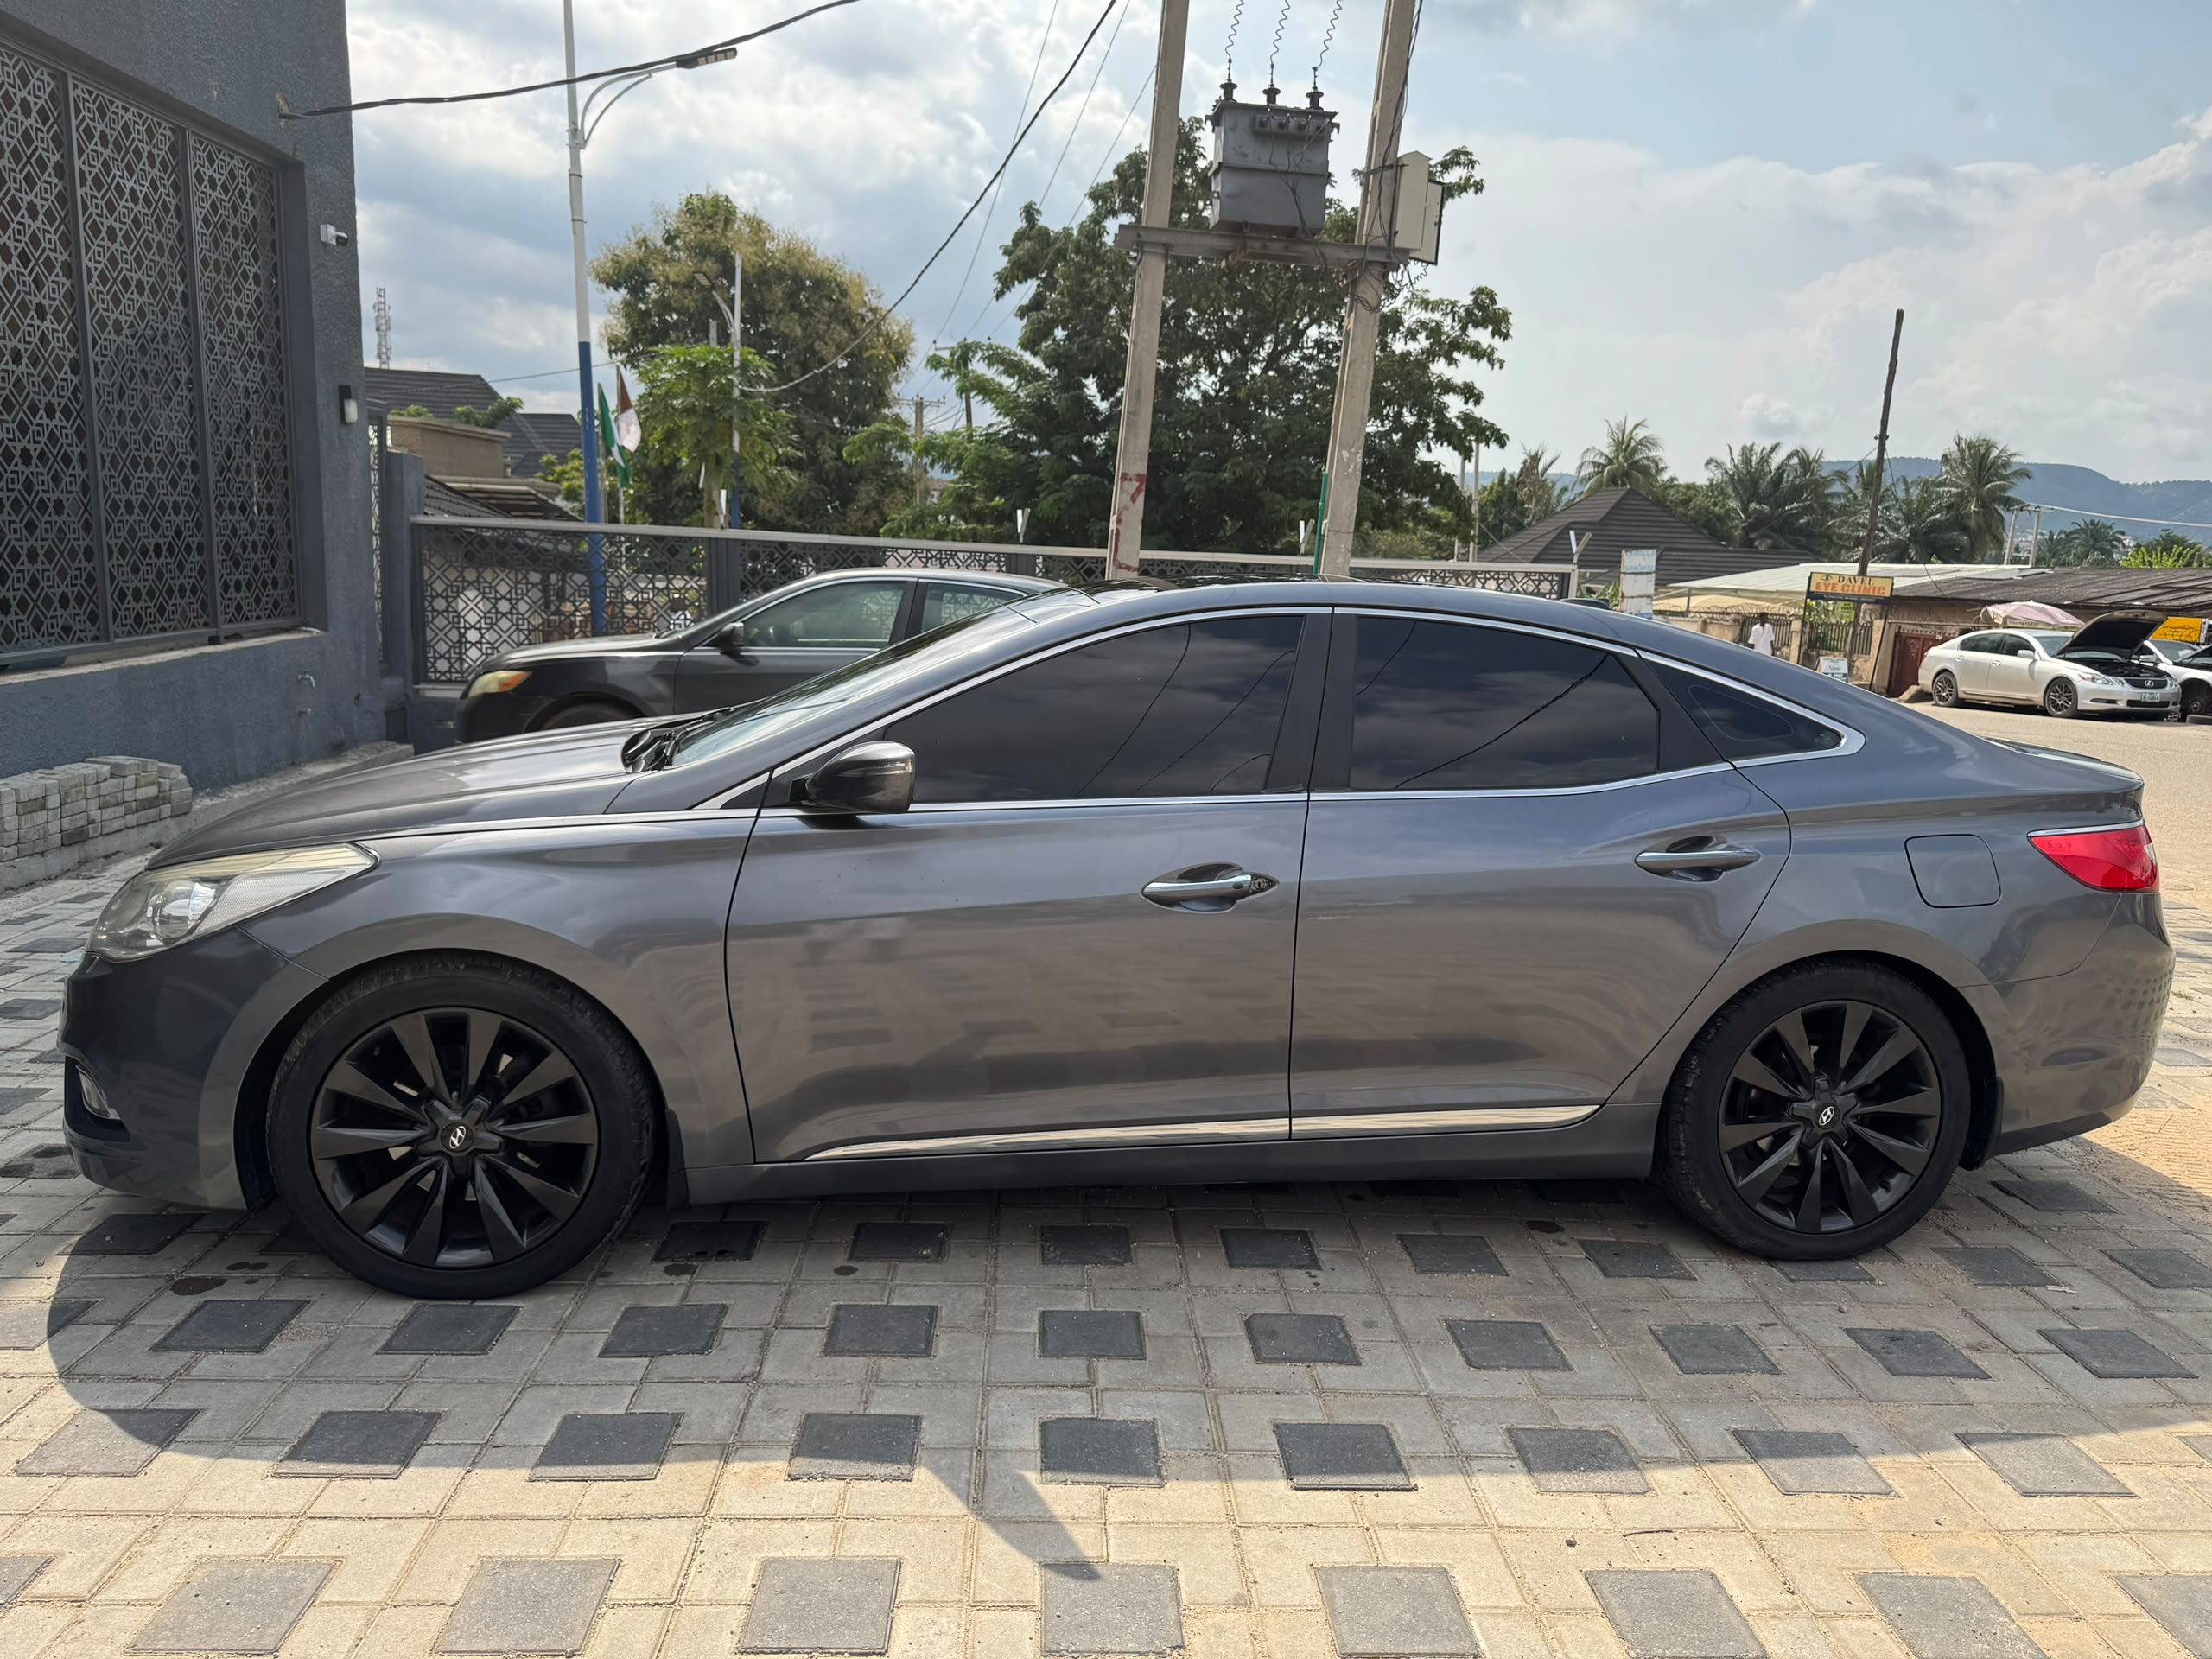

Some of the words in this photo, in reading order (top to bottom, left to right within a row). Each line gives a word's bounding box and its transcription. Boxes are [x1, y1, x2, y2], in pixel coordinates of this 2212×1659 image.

[1838, 575, 1874, 586] DAVEL
[1815, 582, 1838, 593] EYE
[1841, 584, 1886, 595] CLINIC
